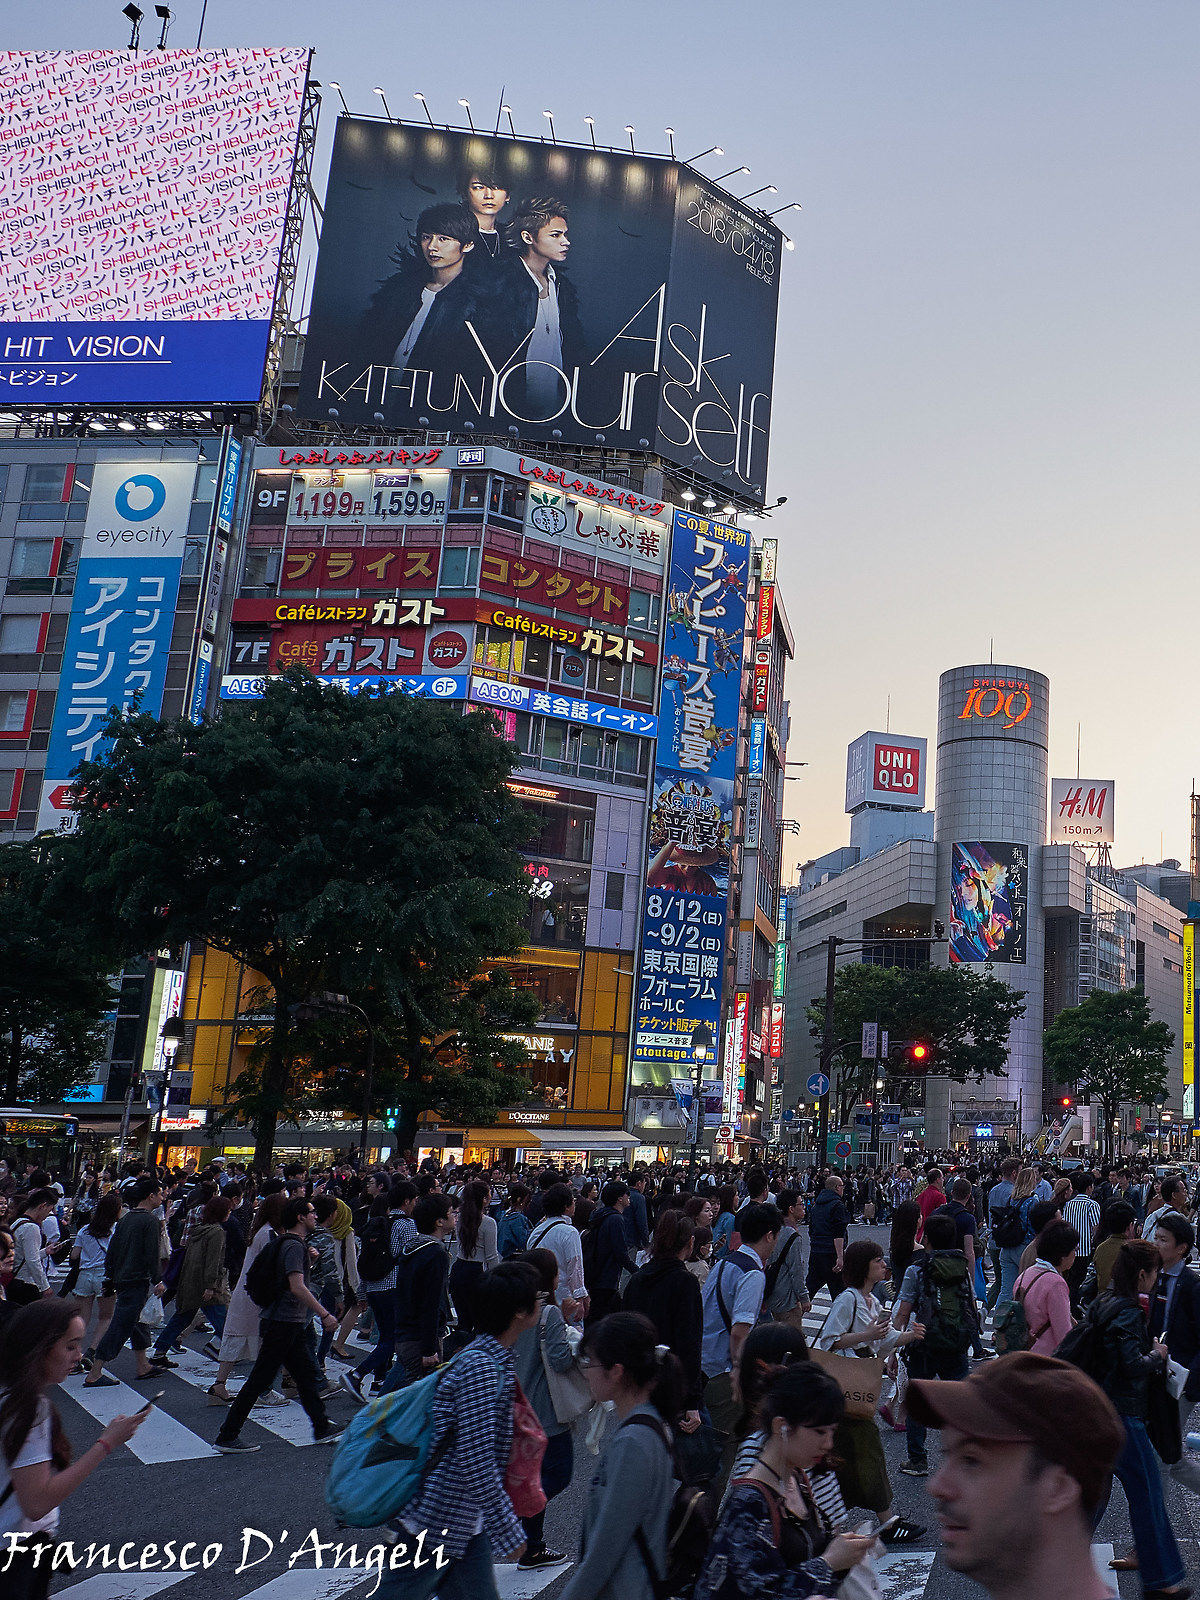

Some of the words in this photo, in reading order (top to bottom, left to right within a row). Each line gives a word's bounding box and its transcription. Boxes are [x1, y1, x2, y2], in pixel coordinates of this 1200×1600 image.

[35, 62, 58, 77] HIT
[52, 70, 75, 85] HIT
[81, 53, 131, 75] VISION
[141, 48, 229, 83] SHIBUHACHI
[75, 102, 98, 117] HIT
[105, 84, 154, 106] VISION
[165, 80, 252, 115] SHIBUHACHI
[259, 70, 281, 85] HIT
[182, 87, 270, 122] SHIBUHACHI
[93, 109, 115, 125] HIT
[122, 92, 171, 114] VISION
[206, 119, 294, 155] SHIBUHACHI
[20, 152, 108, 187] SHIBUHACHI
[146, 124, 195, 147] VISION
[38, 160, 126, 195] SHIBUHACHI
[163, 131, 212, 154] VISION
[60, 192, 150, 228] SHIBUHACHI
[187, 164, 237, 187] VISION
[78, 200, 167, 236] SHIBUHACHI
[205, 171, 255, 194] VISION
[102, 234, 192, 269] SHIBUHACHI
[230, 205, 279, 229] VISION
[687, 201, 775, 276] 2018/04/18
[18, 245, 70, 268] VISION
[36, 253, 87, 276] VISION
[120, 242, 209, 277] SHIBUHACHI
[745, 263, 773, 286] RELEASE
[60, 287, 111, 310] VISION
[77, 295, 129, 318] VISION
[144, 275, 235, 312] SHIBUHACHI
[5, 336, 53, 358] HIT
[66, 336, 165, 358] VISION
[589, 282, 731, 409] Ask
[279, 448, 442, 466] しゃぶしゃぶバイキング
[312, 477, 341, 487] ランチ
[518, 457, 667, 518] しゃぶしゃぶバイキング
[257, 489, 287, 508] 9F
[294, 490, 364, 521] 1,199円
[373, 490, 445, 520] 1,599円
[95, 525, 174, 548] eyecity
[575, 509, 661, 558] しゃぶ葉
[677, 512, 747, 547] この夏、世界初
[286, 551, 434, 581] プライス
[482, 554, 625, 614] コンタクト
[371, 599, 446, 626] ガスト
[235, 641, 270, 662] 7F
[278, 640, 319, 657] Café
[321, 636, 415, 672] ガスト
[432, 648, 463, 659] ガスト
[581, 629, 646, 662] ガスト
[66, 576, 129, 762] アイシティ
[973, 678, 1031, 691] SHIBUYA
[435, 679, 455, 693] 6F
[755, 676, 767, 706] ガスト
[477, 682, 524, 706] AEON
[532, 692, 655, 730] 英会話イーオン
[957, 687, 1032, 730] 109
[880, 750, 912, 769] UNI
[879, 769, 914, 789] QLO
[748, 791, 758, 843] 渋谷駅前ビル
[1059, 786, 1109, 820] H&M
[1062, 824, 1092, 836] 150m
[643, 949, 719, 978] 東京国際
[1185, 945, 1193, 973] KiYoshi
[641, 974, 717, 1000] フォーラム
[1185, 973, 1193, 1015] Matsumoto
[639, 997, 685, 1014] ホールC
[771, 1025, 781, 1047] アコム
